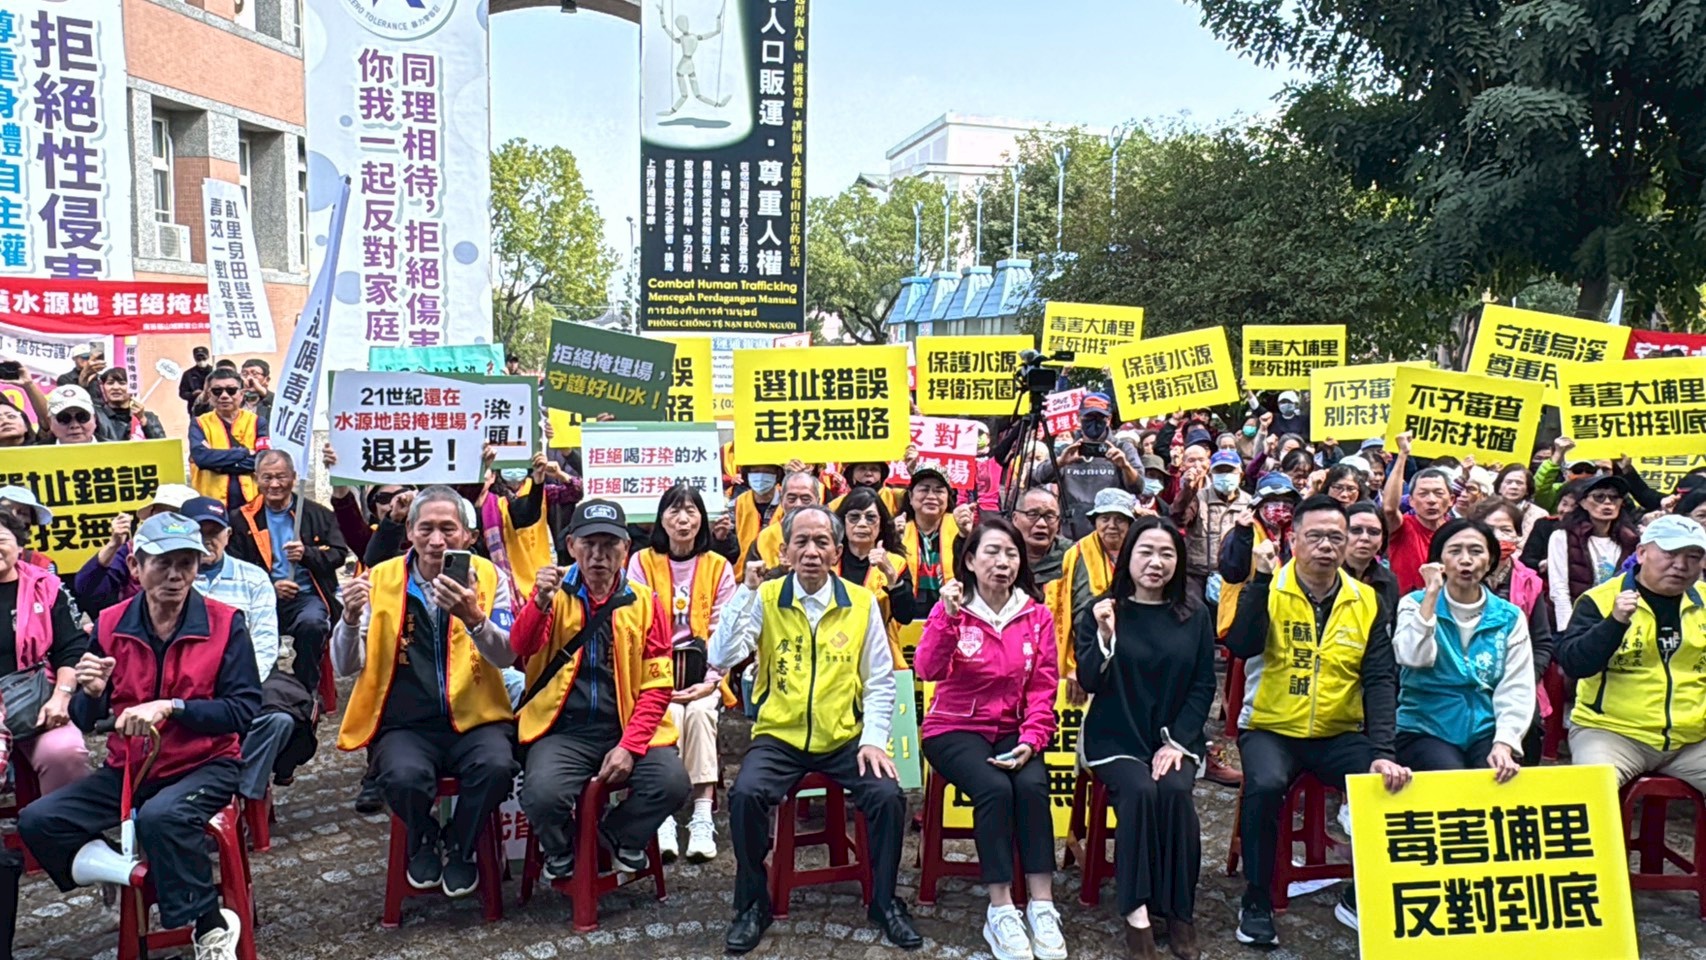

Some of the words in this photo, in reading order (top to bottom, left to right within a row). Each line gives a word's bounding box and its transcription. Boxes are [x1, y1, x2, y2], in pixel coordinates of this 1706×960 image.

[346, 0, 365, 14] ERO
[364, 11, 408, 31] TOLERANCE
[357, 48, 401, 342] 你我一起反對家庭
[648, 278, 695, 289] Combat
[697, 279, 738, 290] Human
[740, 280, 798, 294] Trafficking
[648, 292, 695, 304] Mencegah
[697, 293, 757, 305] Perdagangan
[758, 295, 797, 305] Manusia
[647, 318, 678, 328] PHÒNG
[743, 320, 768, 329] BUÔN
[1050, 315, 1136, 337] 毒害大埔里
[7, 339, 74, 360] 、誓死守護
[1048, 335, 1134, 355] 誓死拼到
[1249, 339, 1339, 356] 毒害大埔里
[1494, 323, 1608, 363] 守護烏溪
[552, 342, 666, 384] 拒絕掩埋場，
[927, 351, 1017, 374] 保護水源
[1121, 343, 1214, 380] 保護水源
[360, 387, 461, 407] 21世紀還在
[547, 370, 662, 410] 守護好山水！
[754, 367, 890, 403] 選址錯誤
[927, 378, 1016, 401] 捍衛家園
[1127, 369, 1220, 405] 捍衛家園
[1324, 378, 1396, 402] 不予審
[1568, 377, 1706, 409] 毒害大埔里
[1408, 383, 1525, 423] 不予審查
[334, 412, 482, 432] 水源地設掩埋場？
[484, 425, 523, 445] 頭！
[754, 407, 890, 443] 走投無路
[1404, 414, 1518, 453] 別來找碴
[1571, 407, 1706, 440] 誓死拼到底
[361, 437, 456, 473] 退步！
[26, 509, 139, 553] 投無
[1288, 621, 1314, 696] 蘇昱誠
[1384, 803, 1595, 866] 毒害埔里
[1391, 871, 1603, 939] 反對到底
